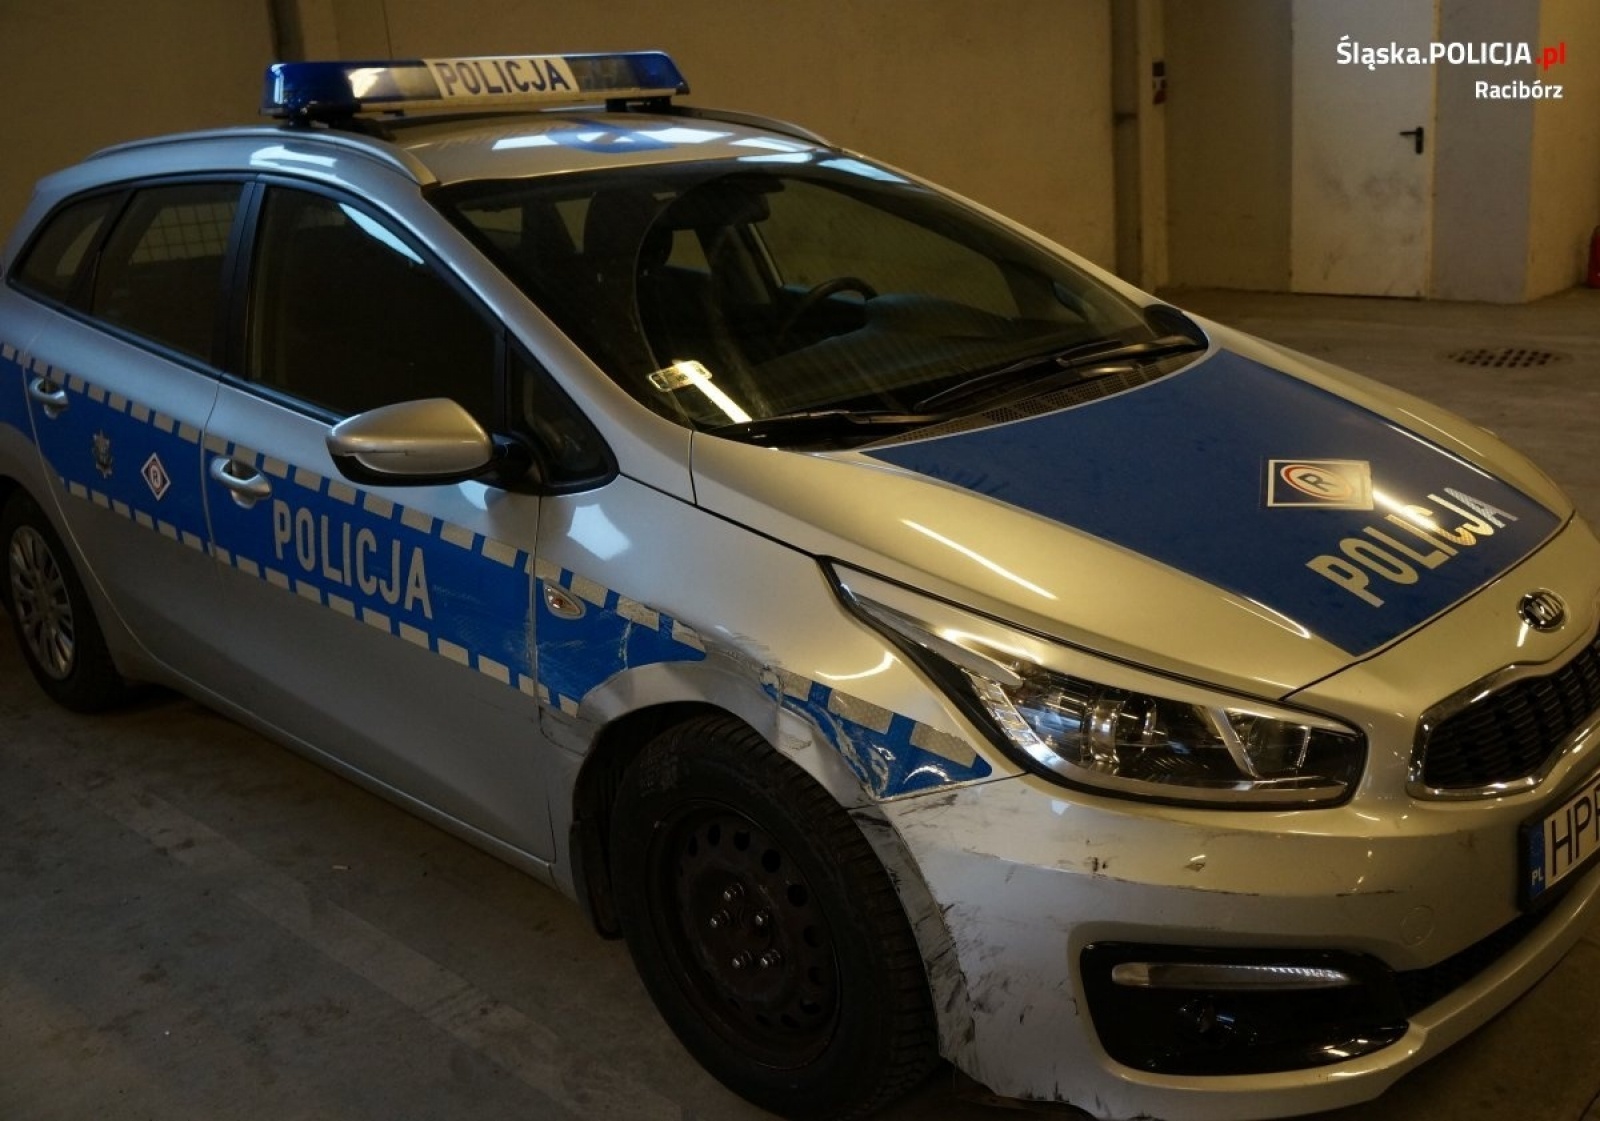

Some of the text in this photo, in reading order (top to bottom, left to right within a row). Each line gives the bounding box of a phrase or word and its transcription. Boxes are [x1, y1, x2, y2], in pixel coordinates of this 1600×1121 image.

[433, 58, 570, 96] POLICJA
[1297, 472, 1337, 493] R
[272, 499, 433, 620] POLICJA
[1304, 487, 1519, 608] POLICJA
[1531, 867, 1544, 886] PL
